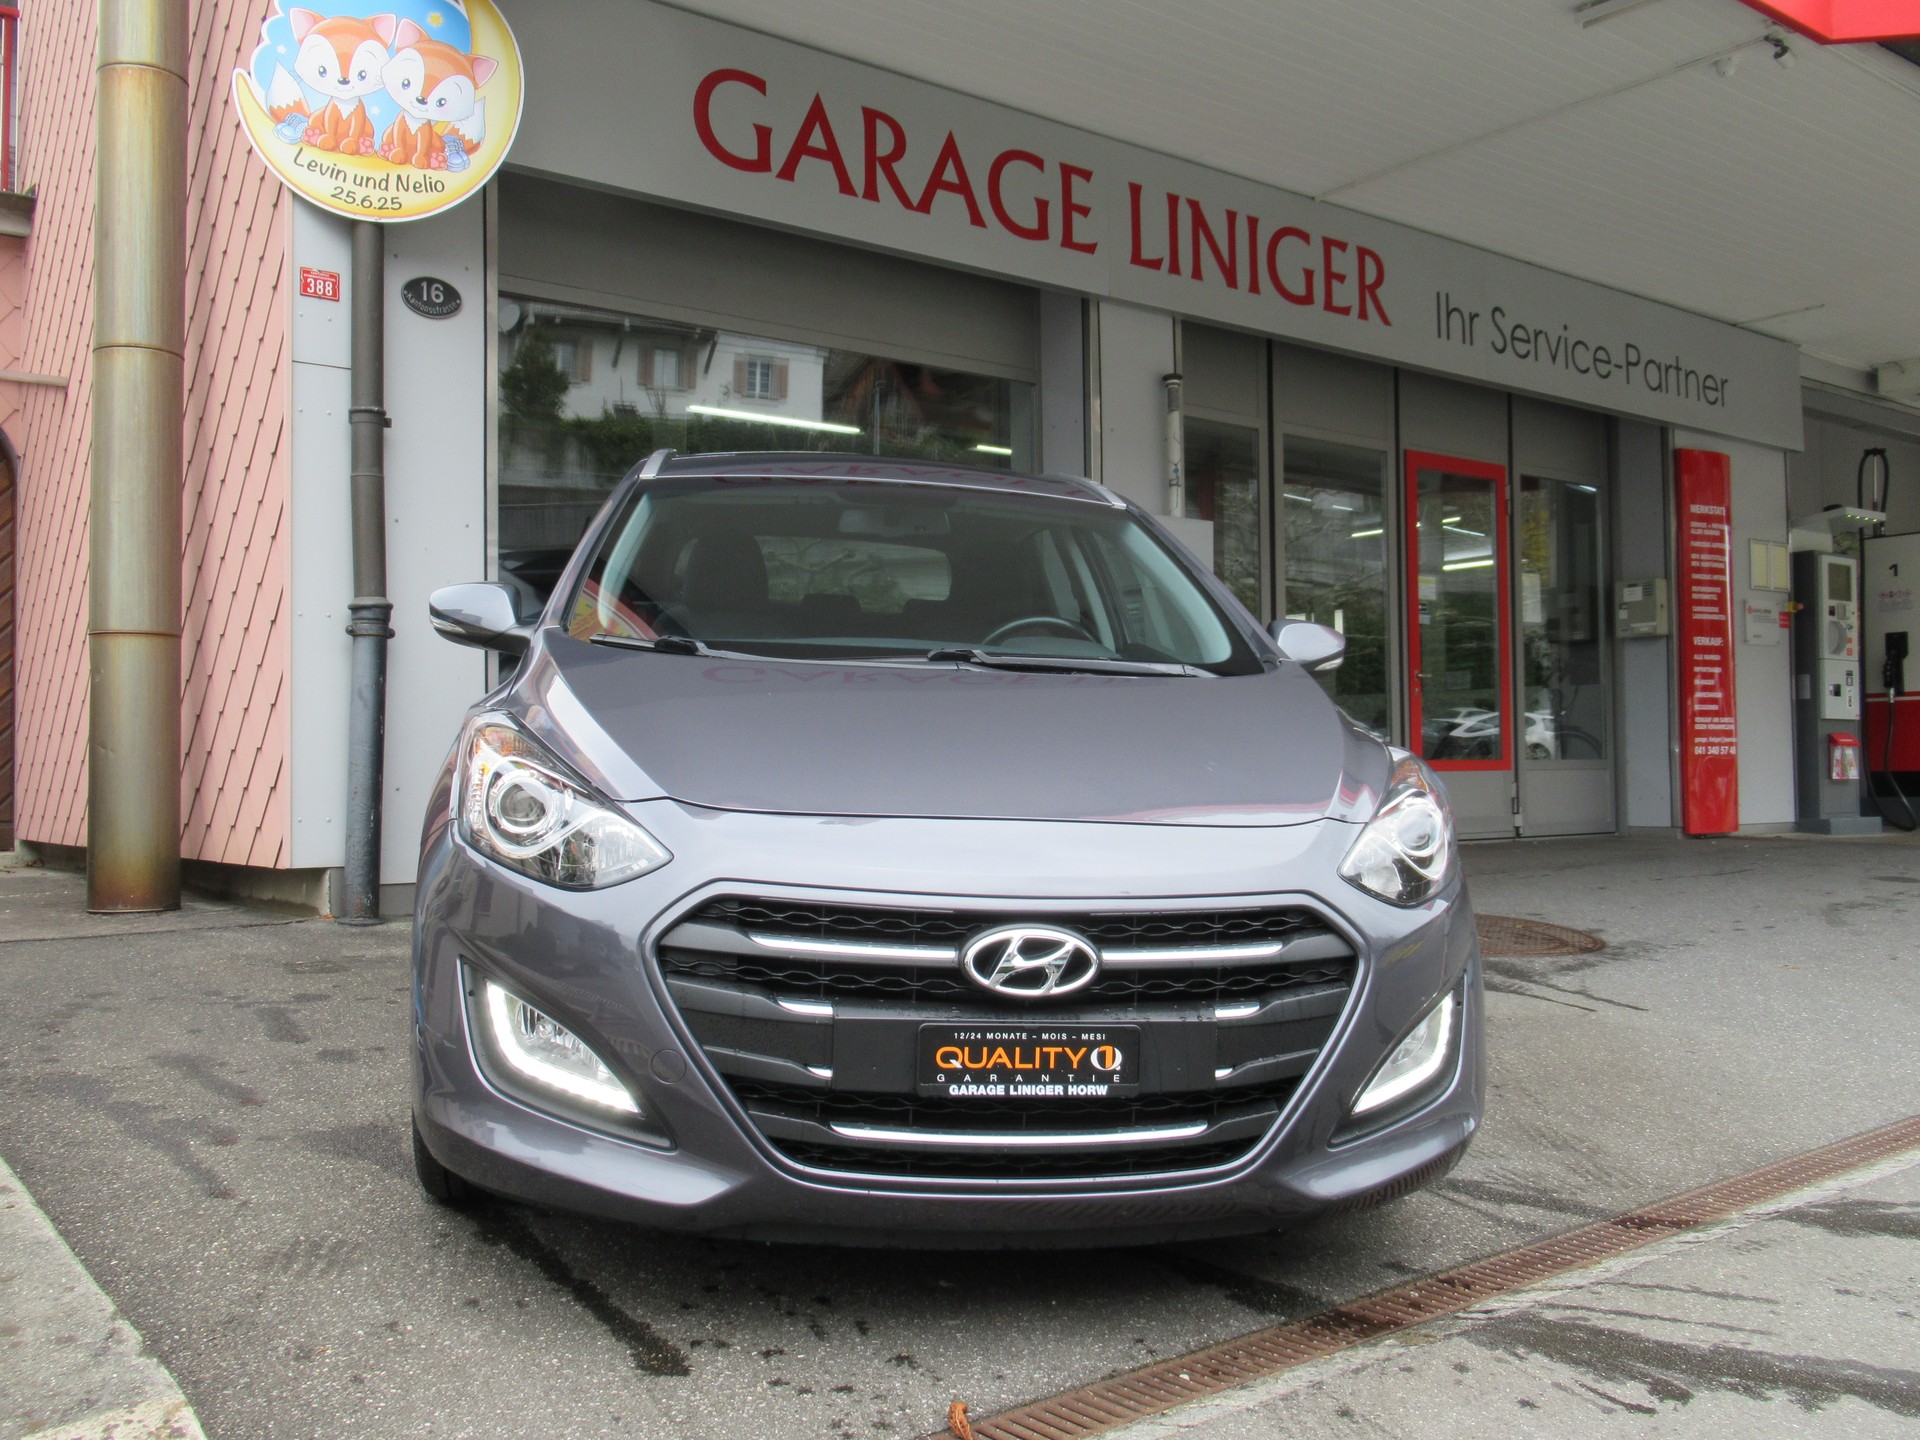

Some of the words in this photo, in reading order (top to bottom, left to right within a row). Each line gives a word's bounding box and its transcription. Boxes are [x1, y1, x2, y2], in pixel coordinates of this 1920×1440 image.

[293, 146, 347, 183] Levin
[353, 172, 390, 192] und
[396, 173, 445, 193] Nelio
[330, 186, 402, 211] 25.6.25
[693, 68, 1099, 255] GARAGE
[1128, 181, 1392, 327] LINIGER
[306, 278, 333, 296] 388
[420, 281, 444, 303] 16
[1436, 291, 1480, 346] Ihr
[1491, 306, 1729, 407] Service-Partner
[1888, 563, 1899, 577] 1
[953, 1032, 982, 1040] 12/24
[986, 1032, 1028, 1040] MONATE
[1041, 1032, 1067, 1040] MOIS
[935, 1046, 1087, 1069] QUALITY
[936, 1074, 1120, 1083] GARANTIE
[949, 1084, 1005, 1096] GARAGE
[1009, 1084, 1064, 1096] LINIGER
[1068, 1084, 1108, 1096] HORW
